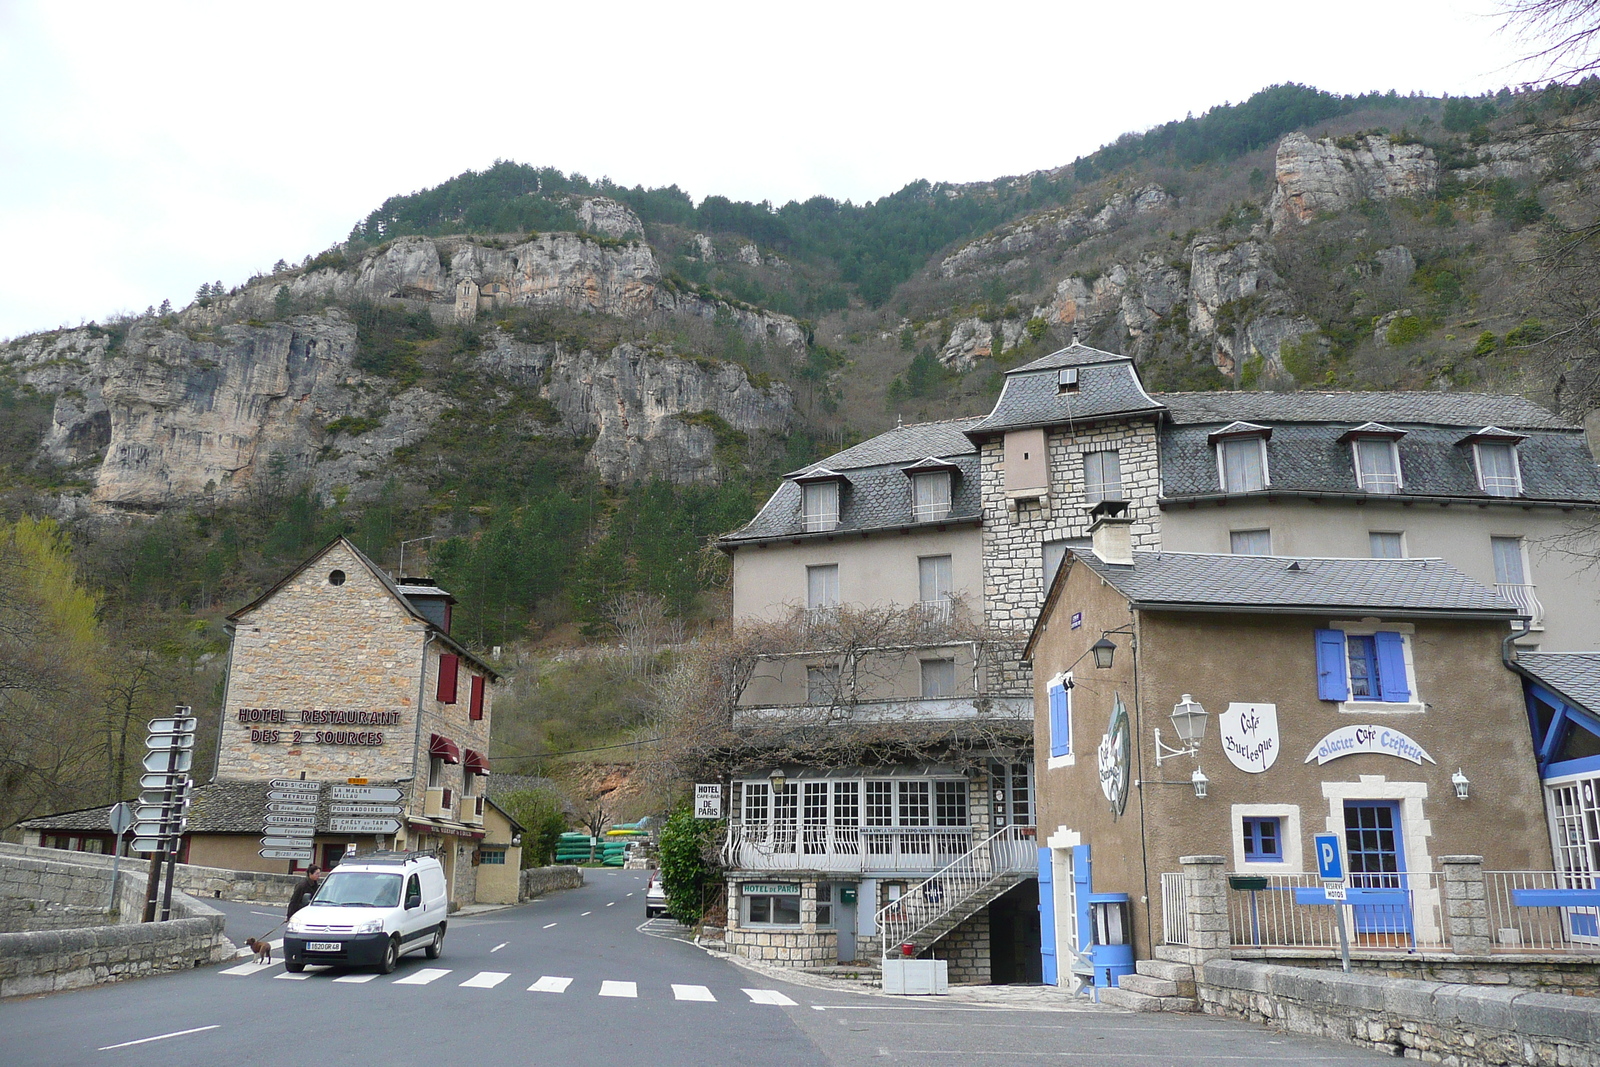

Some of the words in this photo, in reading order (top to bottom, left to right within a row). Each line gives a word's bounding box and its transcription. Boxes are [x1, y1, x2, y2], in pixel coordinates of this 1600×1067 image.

[238, 708, 286, 723] HOTEL
[301, 710, 400, 725] RESTAURANT
[1241, 708, 1260, 738] Café
[251, 729, 280, 743] DES
[293, 730, 301, 743] 2
[315, 731, 384, 746] SOURCES
[1225, 736, 1272, 769] Burlesque
[1318, 736, 1354, 757] Glacier
[698, 785, 719, 793] HOTEL
[698, 807, 718, 816] PARIS
[703, 800, 712, 808] DE
[1321, 843, 1334, 871] P
[744, 885, 768, 893] HOTEL
[777, 885, 799, 893] PARIS
[1327, 890, 1344, 898] MOTOS
